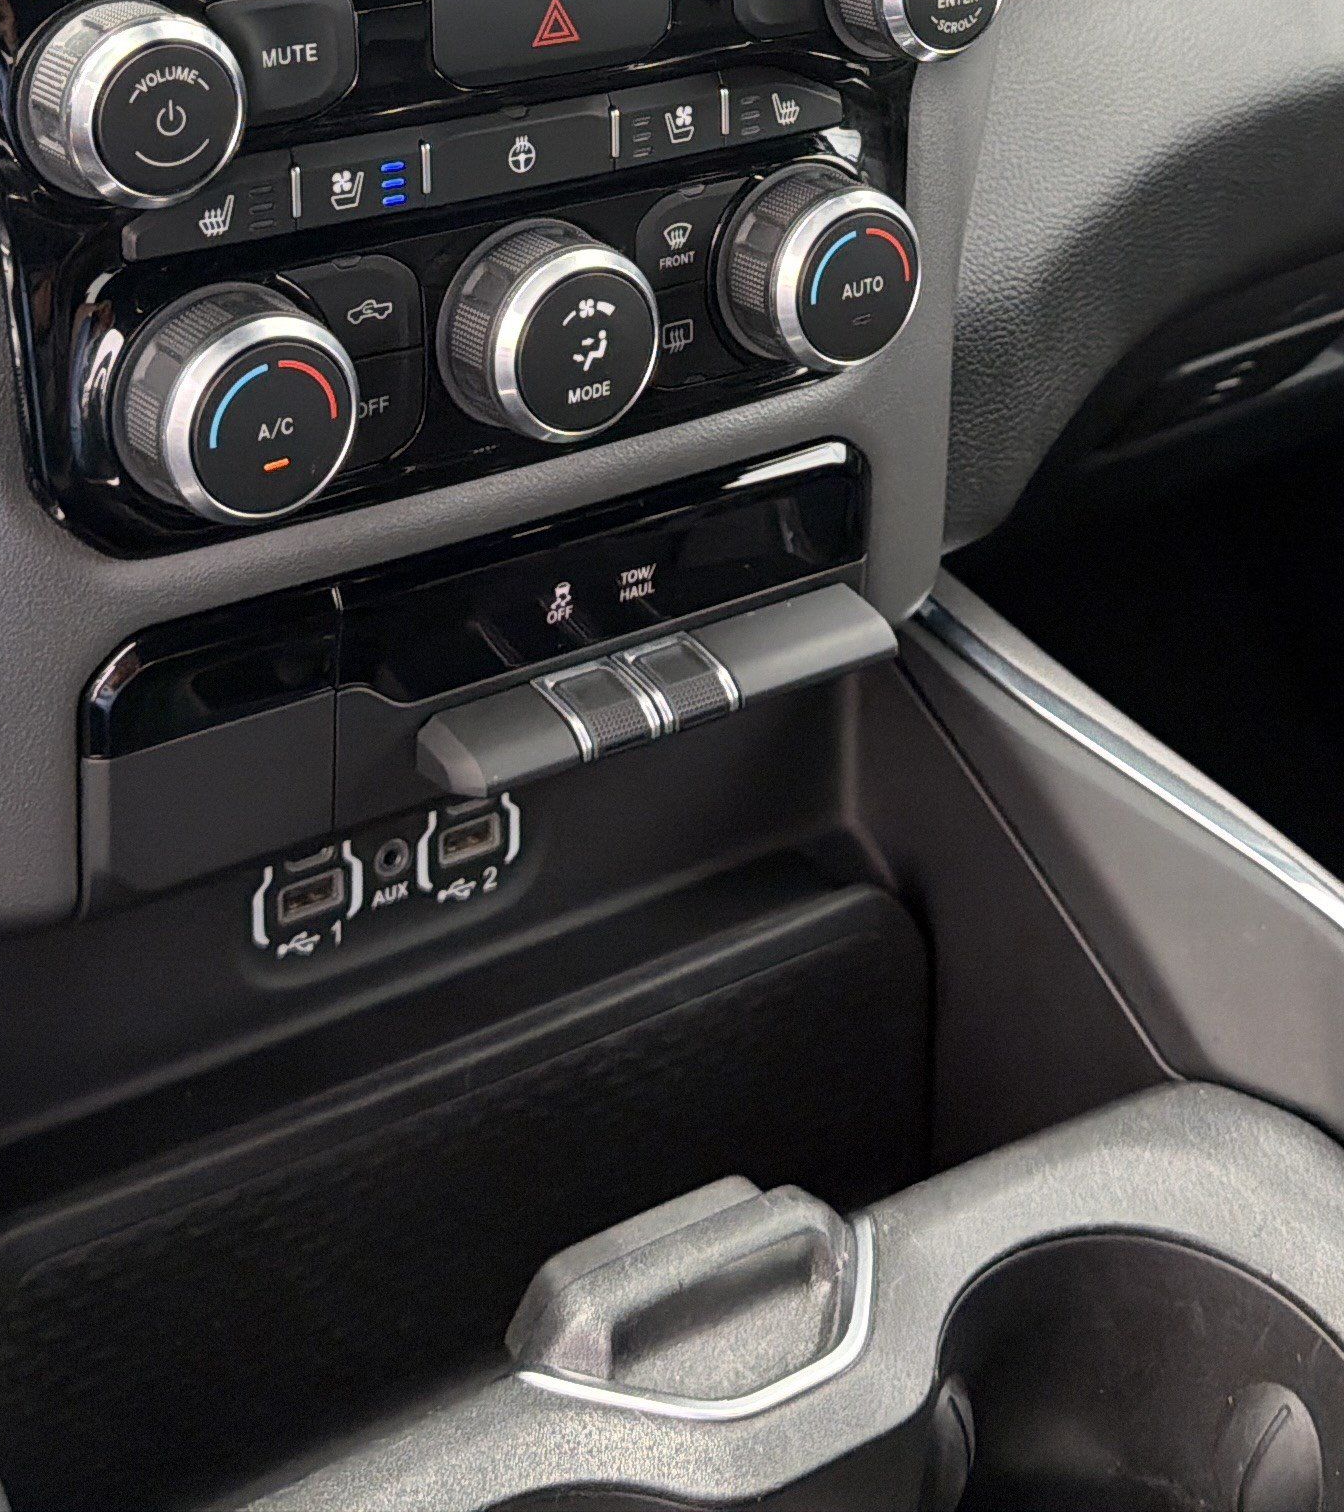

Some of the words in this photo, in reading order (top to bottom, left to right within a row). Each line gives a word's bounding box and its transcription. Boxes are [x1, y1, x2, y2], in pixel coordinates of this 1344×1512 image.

[936, 13, 977, 35] SCROLL
[262, 42, 318, 68] MUTE
[135, 67, 200, 94] VOLUME
[659, 250, 695, 270] FRONT
[841, 276, 884, 300] AUTO
[567, 380, 611, 404] MODE
[258, 417, 295, 441] A/C
[620, 563, 657, 586] TOW/
[619, 581, 655, 603] HAUL
[546, 605, 574, 625] OFF
[483, 866, 498, 893] 2
[371, 881, 409, 908] AUX
[331, 920, 342, 945] 1
